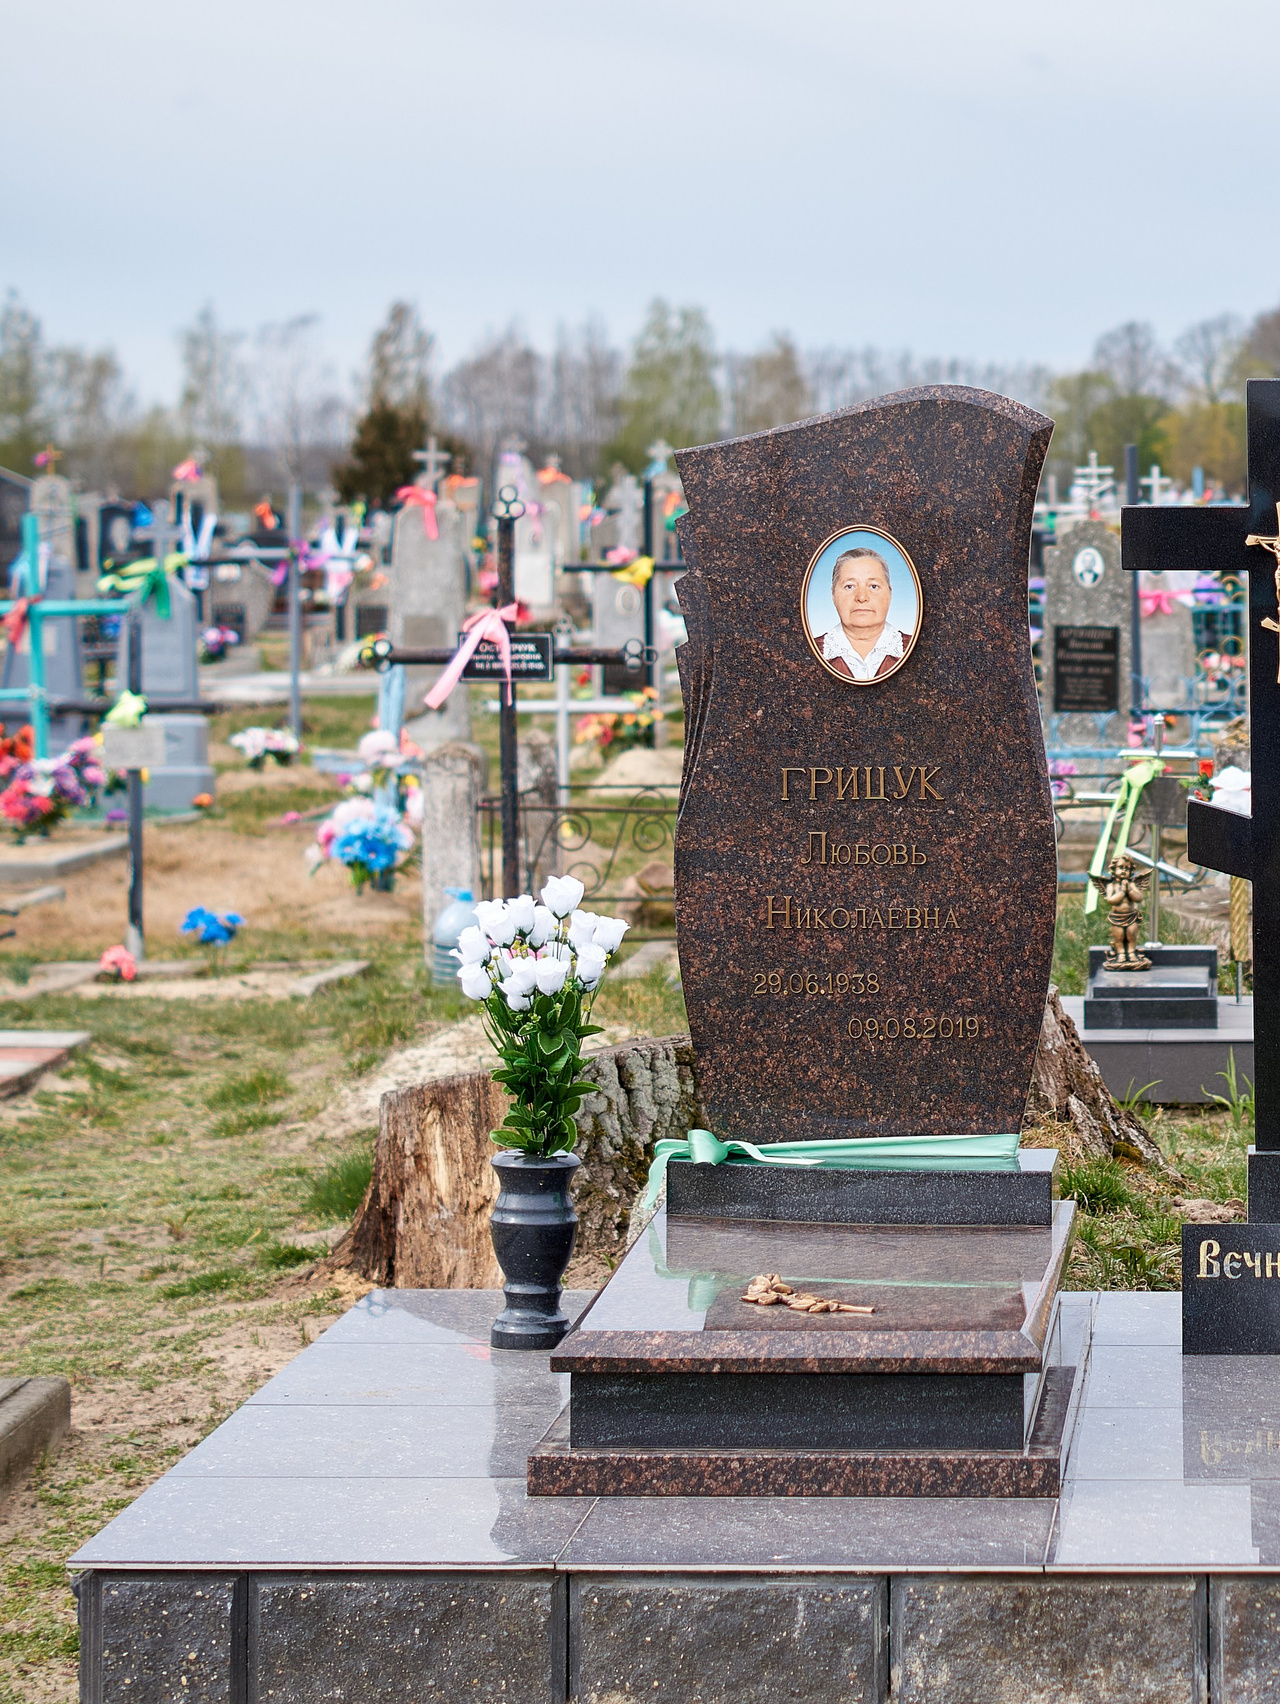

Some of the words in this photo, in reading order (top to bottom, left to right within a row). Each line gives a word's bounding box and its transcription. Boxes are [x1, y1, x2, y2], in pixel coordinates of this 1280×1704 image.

[780, 765, 945, 803] ГРИЦУК
[752, 973, 881, 996] 29.06.1938
[847, 1017, 980, 1041] 09.08.2019
